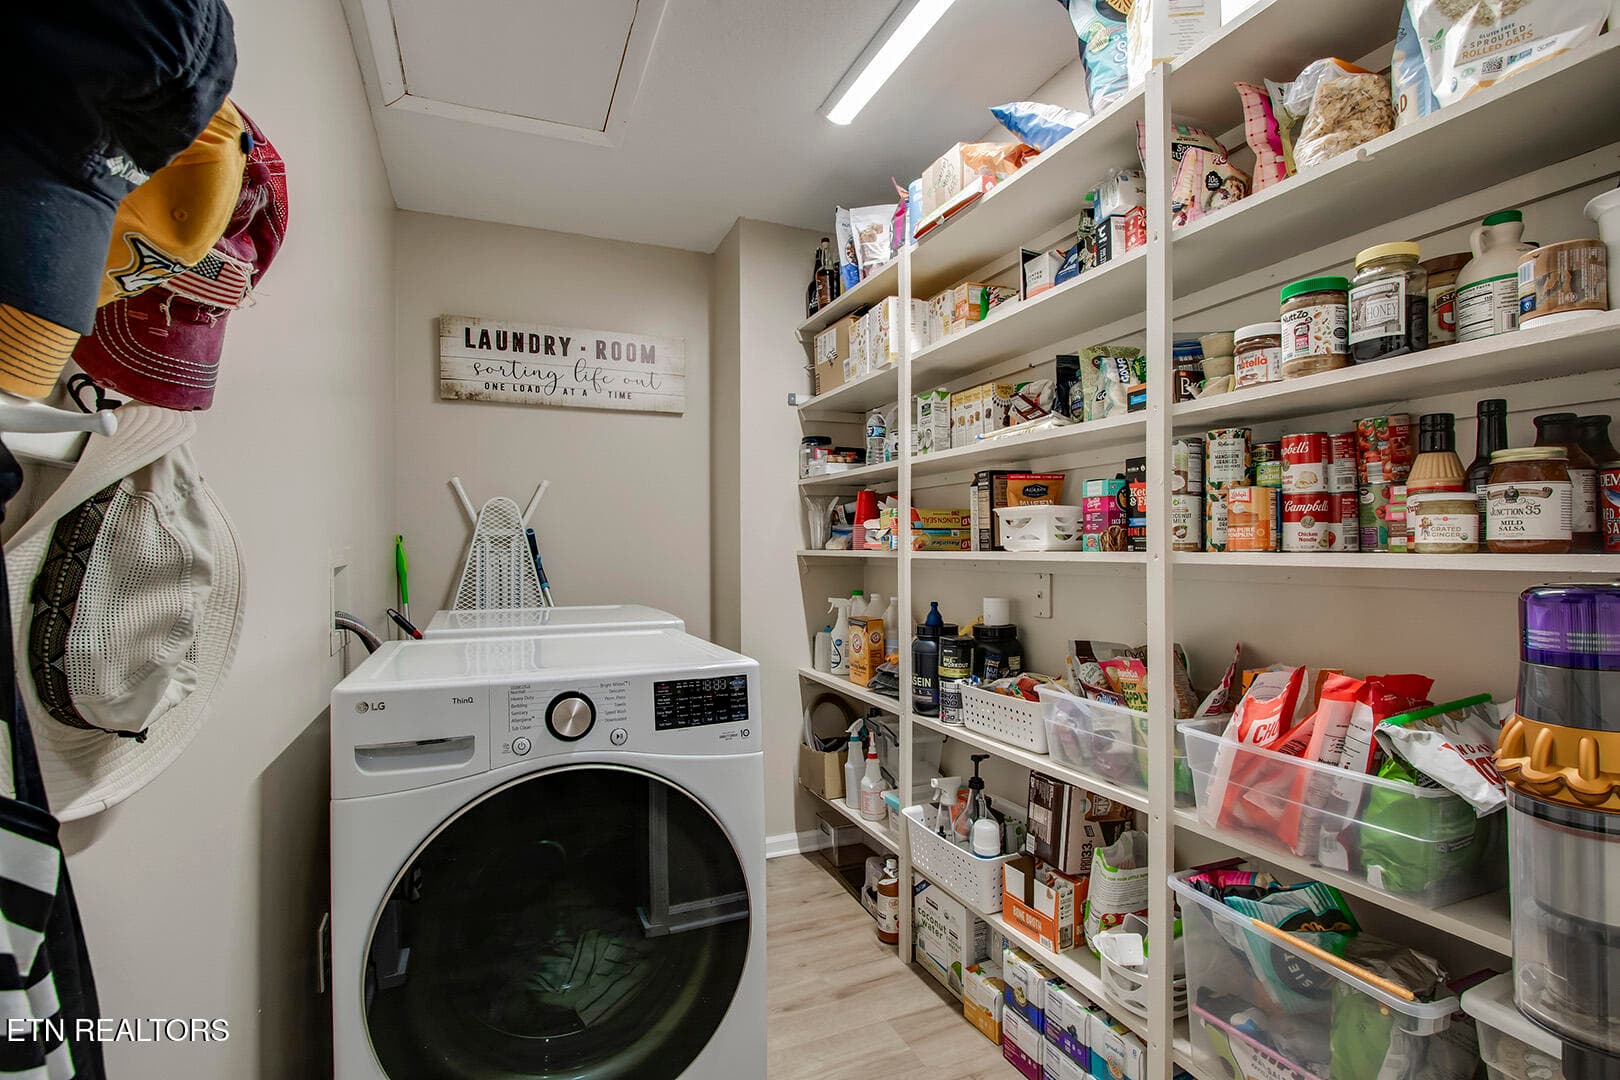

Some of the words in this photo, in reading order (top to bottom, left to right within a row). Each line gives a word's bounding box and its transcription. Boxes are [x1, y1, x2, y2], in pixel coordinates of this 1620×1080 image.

[1462, 43, 1502, 59] ROLLED
[1504, 31, 1533, 46] OATS
[1470, 25, 1526, 48] SPROUTED
[1367, 303, 1398, 319] HONEY
[464, 327, 572, 356] LAUNDRY
[595, 339, 656, 364] ROOM
[473, 359, 564, 396] sorting
[574, 358, 615, 393] life
[623, 371, 662, 391] out
[484, 382, 505, 391] ONE
[513, 383, 541, 393] LOAD
[562, 386, 575, 396] AT
[582, 388, 588, 397] A
[608, 391, 633, 400] TIME
[1525, 504, 1542, 515] 35
[912, 677, 931, 688] SEIN
[371, 702, 386, 711] LG
[452, 697, 474, 705] ThinQ
[917, 907, 947, 934] coconut
[921, 918, 943, 939] water
